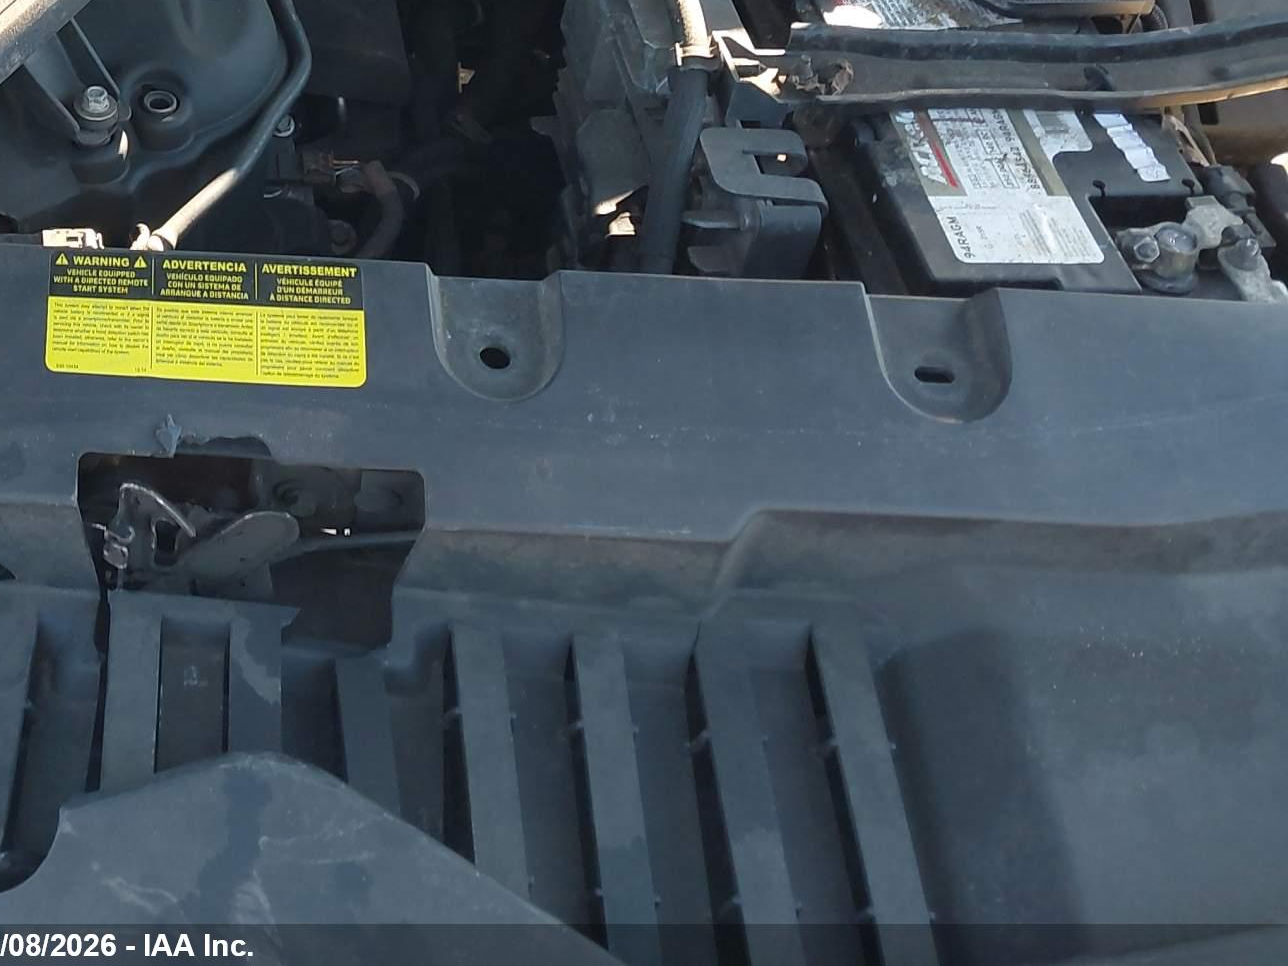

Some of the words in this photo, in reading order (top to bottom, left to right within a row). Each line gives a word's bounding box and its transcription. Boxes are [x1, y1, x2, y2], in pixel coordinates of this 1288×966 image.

[945, 216, 976, 259] 94RAGM
[73, 256, 130, 267] WARNING
[162, 259, 247, 272] ADVERTENCIA
[67, 269, 98, 277] VEHICLE
[98, 270, 136, 279] EQUIPPED
[261, 263, 358, 277] AVERTISSEMENT
[53, 276, 74, 284] WITH
[81, 277, 117, 286] DIRECTED
[117, 279, 149, 287] REMOTE
[166, 272, 204, 282] VEHÍCULO
[206, 274, 243, 283] EQUIPADO
[276, 277, 313, 287] VÉHICULE
[73, 285, 98, 293] START
[98, 286, 129, 294] SYSTEM
[167, 281, 183, 289] CON
[197, 282, 231, 291] SISTEMA
[276, 286, 294, 294] D'UN
[295, 286, 344, 296] DÉMARREUR
[160, 289, 202, 298] ARRANQUE
[209, 291, 249, 300] DISTANCIA
[276, 294, 313, 303] DISTANCE
[314, 295, 351, 305] DIRECTED
